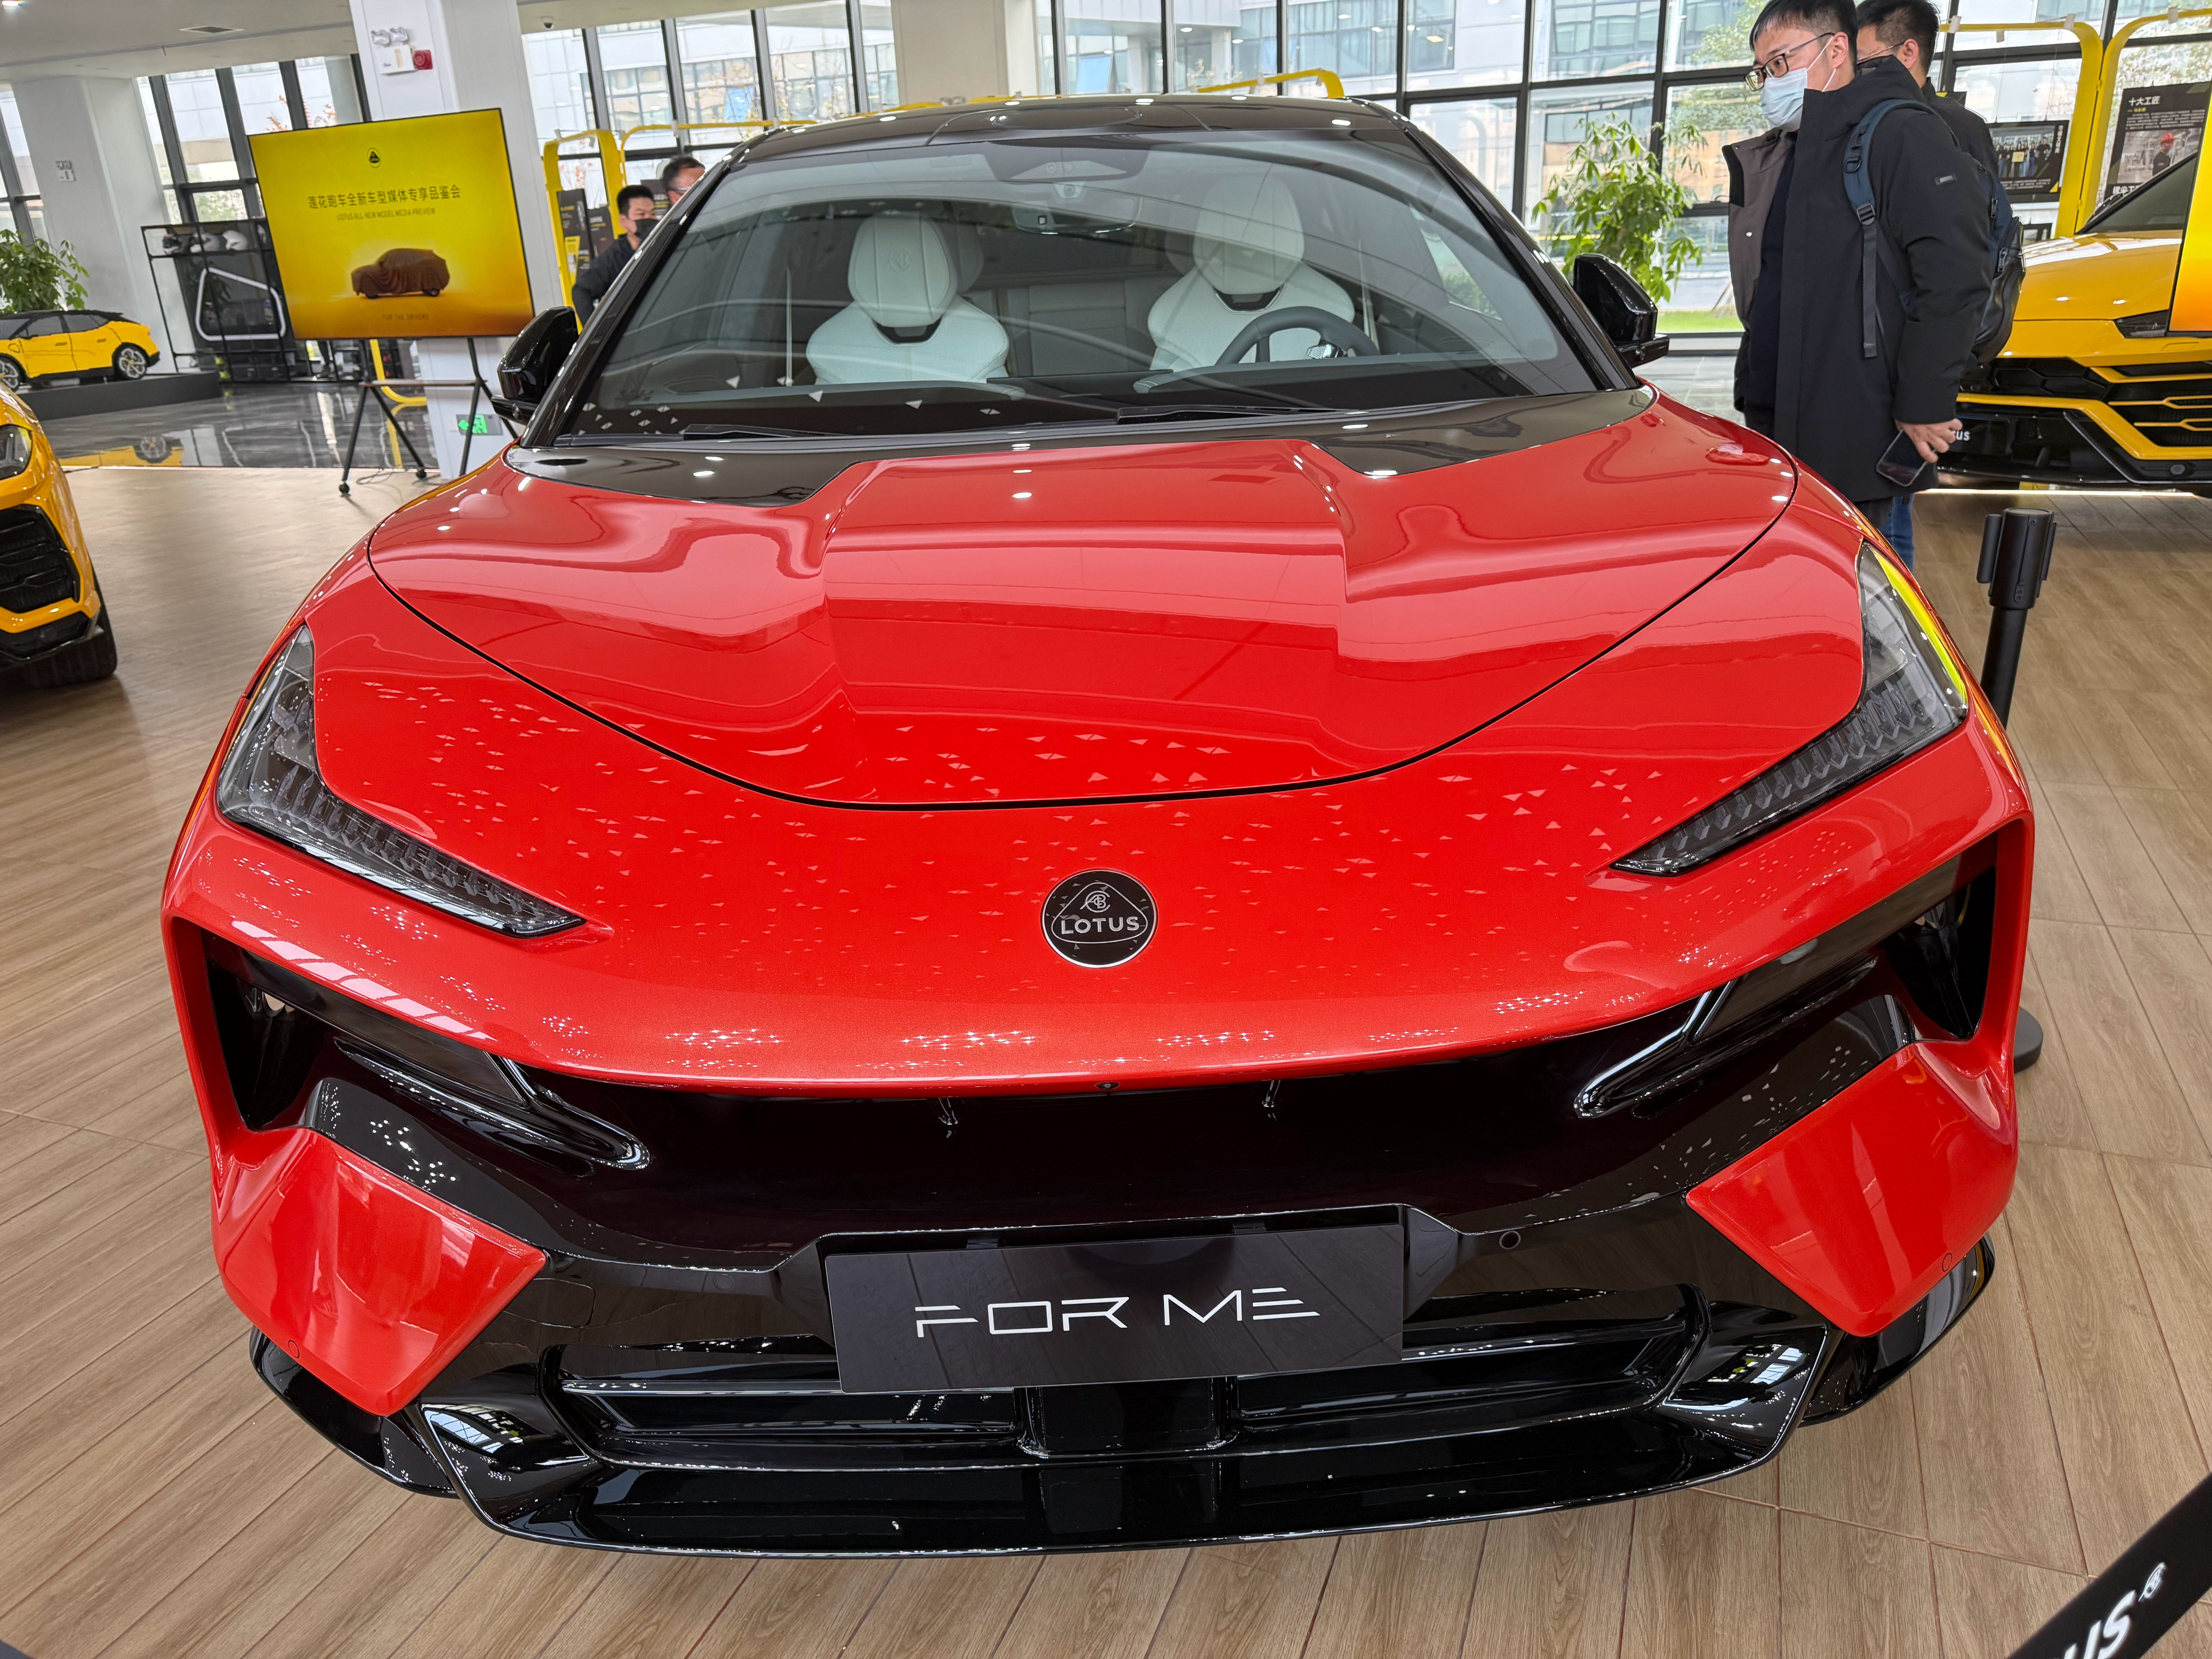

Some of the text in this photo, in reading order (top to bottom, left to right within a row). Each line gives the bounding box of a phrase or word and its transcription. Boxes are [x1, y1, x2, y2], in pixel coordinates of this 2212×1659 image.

[2128, 96, 2160, 106] 十大工匠
[308, 184, 460, 209] 莲花跑车全新车型媒体专享品鉴会
[1952, 430, 1970, 441] us
[1061, 916, 1140, 934] LOTUS
[915, 1288, 1320, 1337] FOR ME
